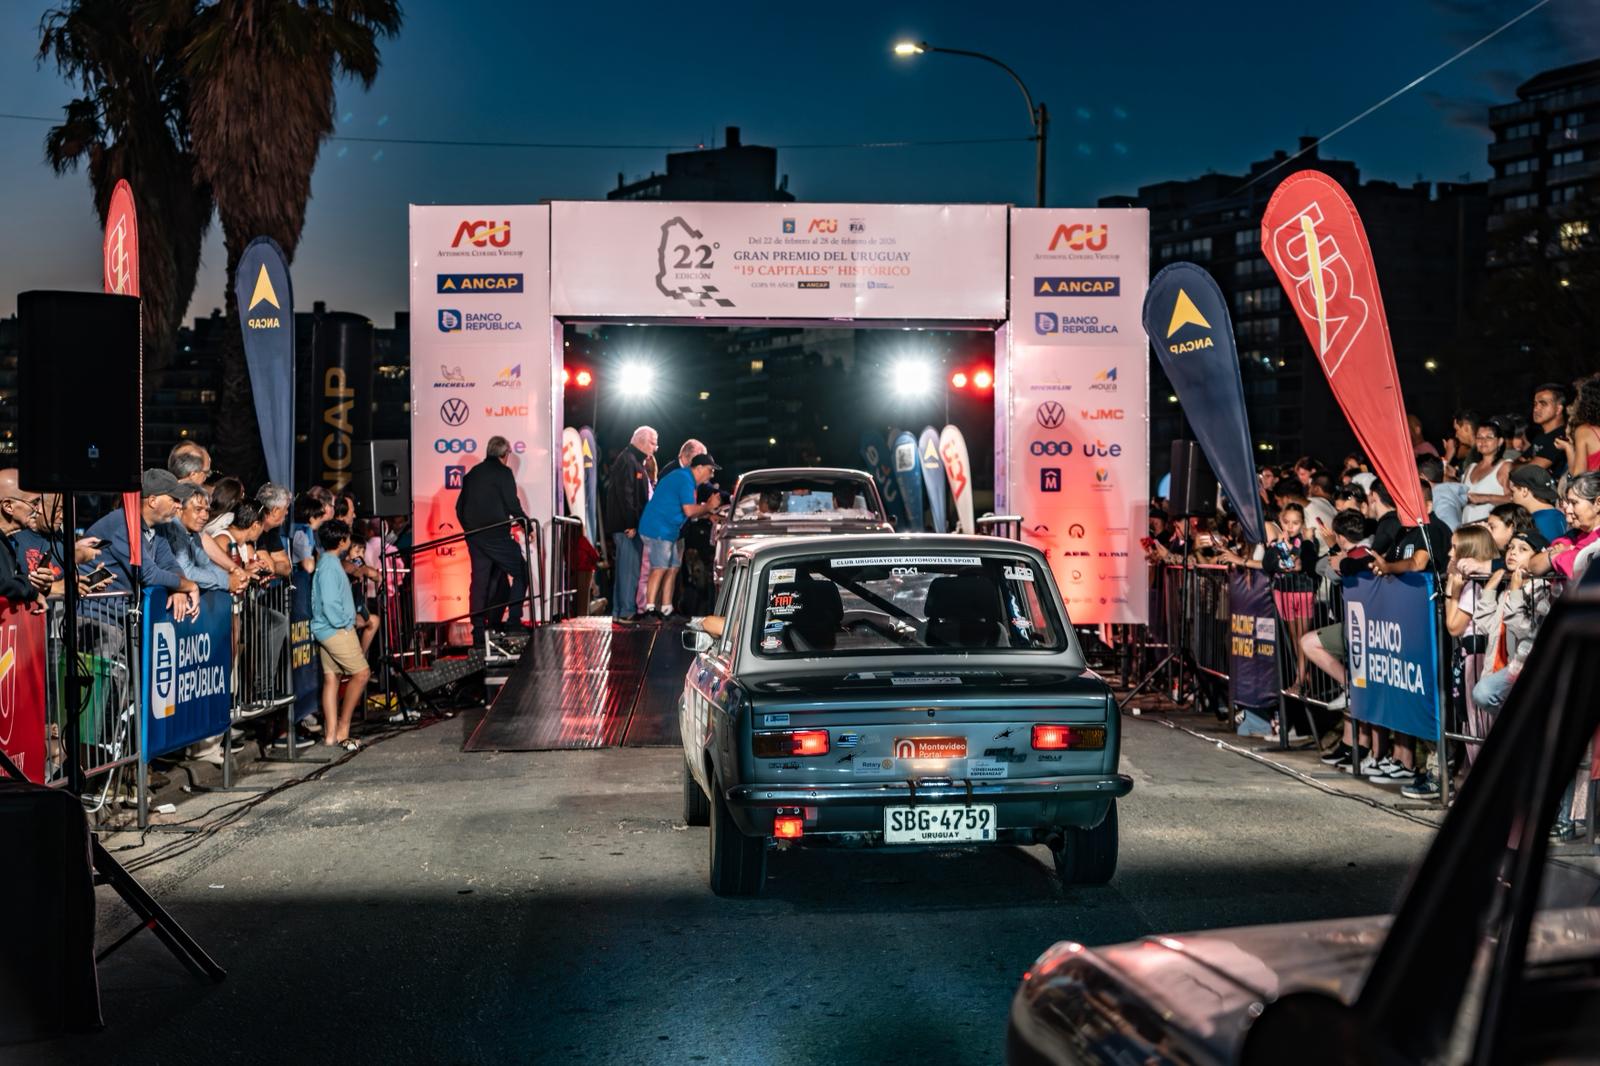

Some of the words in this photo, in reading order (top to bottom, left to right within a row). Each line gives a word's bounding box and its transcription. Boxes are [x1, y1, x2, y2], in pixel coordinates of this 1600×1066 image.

[451, 220, 510, 248] ACU
[1048, 224, 1108, 251] ACU
[734, 251, 769, 260] GRAN
[773, 251, 820, 260] PREMIO
[824, 251, 848, 260] DEL
[851, 251, 910, 260] URUGUAY
[461, 278, 518, 289] ANCAP
[1058, 281, 1115, 292] ANCAP
[1062, 316, 1098, 325] BANCO
[494, 406, 528, 416] JMC
[1090, 410, 1124, 420] JMC
[1083, 440, 1122, 457] ute
[774, 596, 793, 606] FIAT
[1368, 620, 1401, 653] BANCO
[179, 633, 210, 668] BANCO
[1369, 652, 1425, 695] REPÚBLICA
[178, 666, 225, 704] REPÚBLICA
